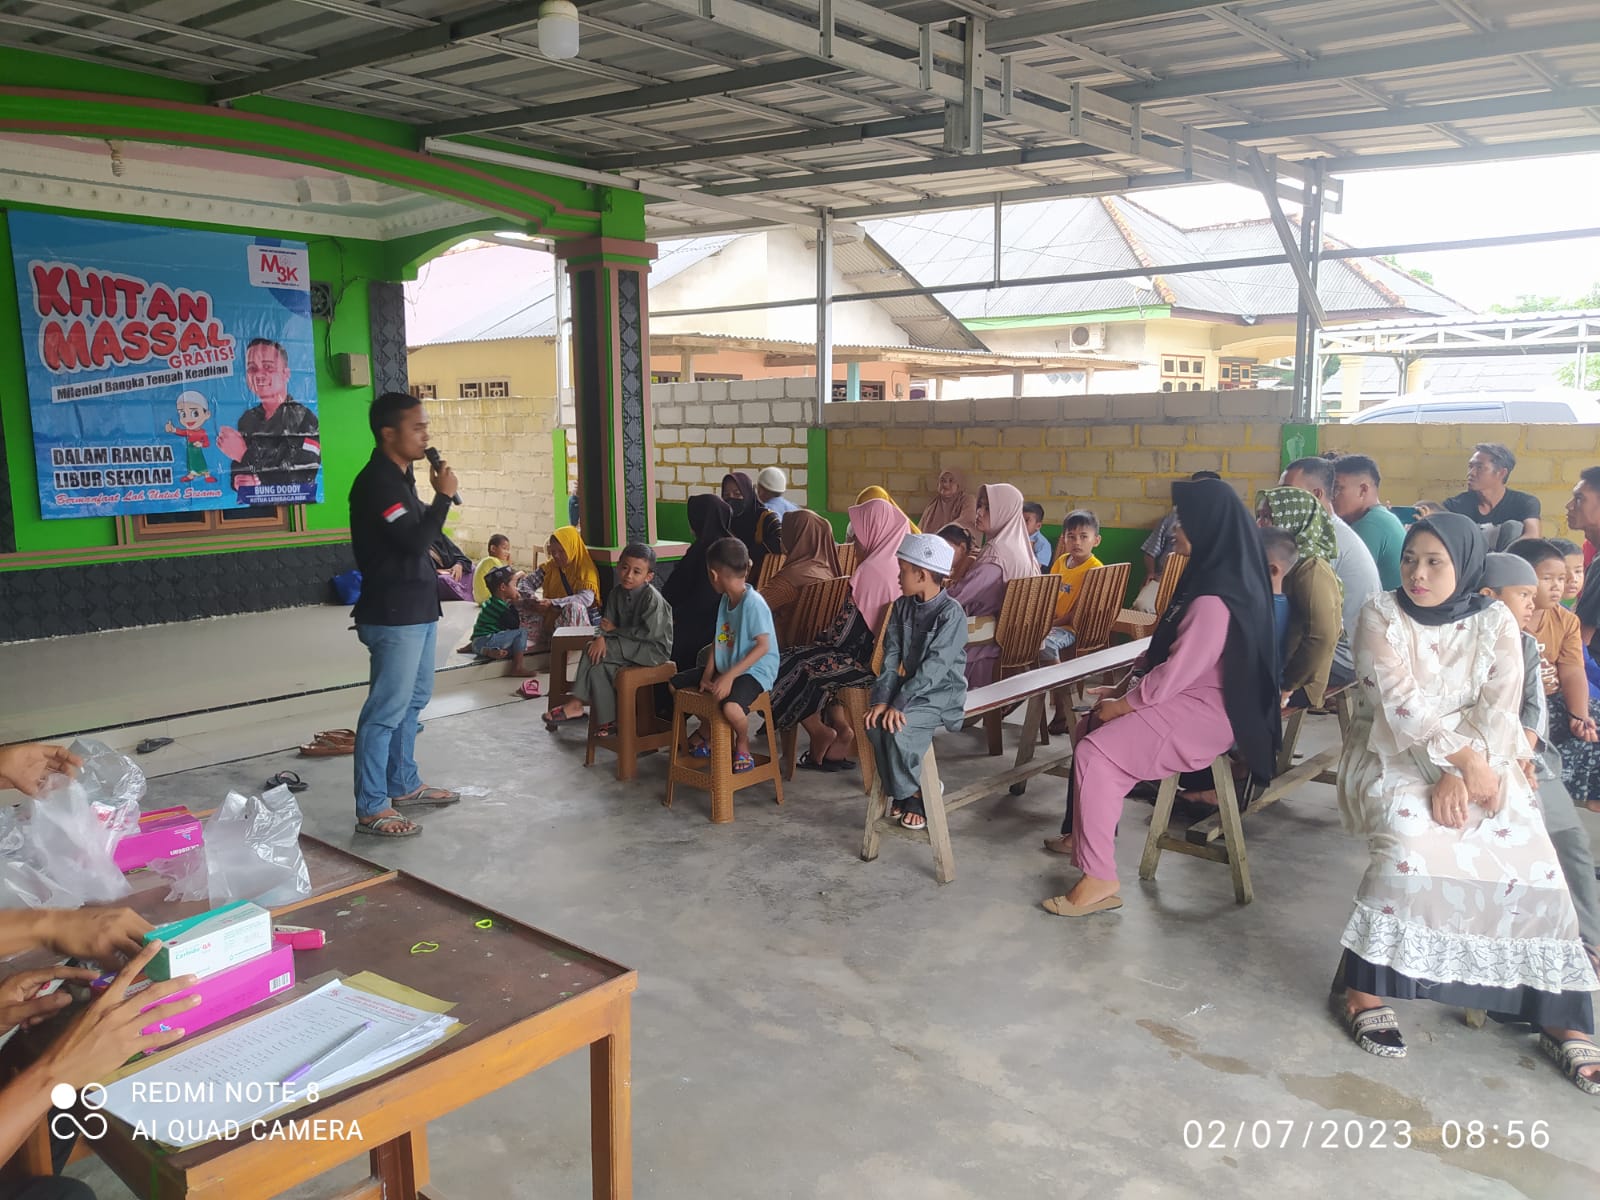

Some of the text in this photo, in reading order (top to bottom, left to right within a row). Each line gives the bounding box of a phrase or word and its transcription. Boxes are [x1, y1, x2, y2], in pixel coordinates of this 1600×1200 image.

[261, 254, 298, 282] M3K
[33, 265, 208, 323] KHITAN
[43, 320, 231, 371] MASSAL
[168, 346, 235, 369] GRATIS!
[105, 377, 145, 393] Bangka
[146, 371, 183, 387] Tengah
[53, 446, 174, 466] DALAM RANGKA
[54, 468, 173, 489] LIBUR SEKOLAH
[122, 490, 144, 501] Lah
[149, 489, 180, 500] Untuk
[254, 485, 276, 495] BUNG
